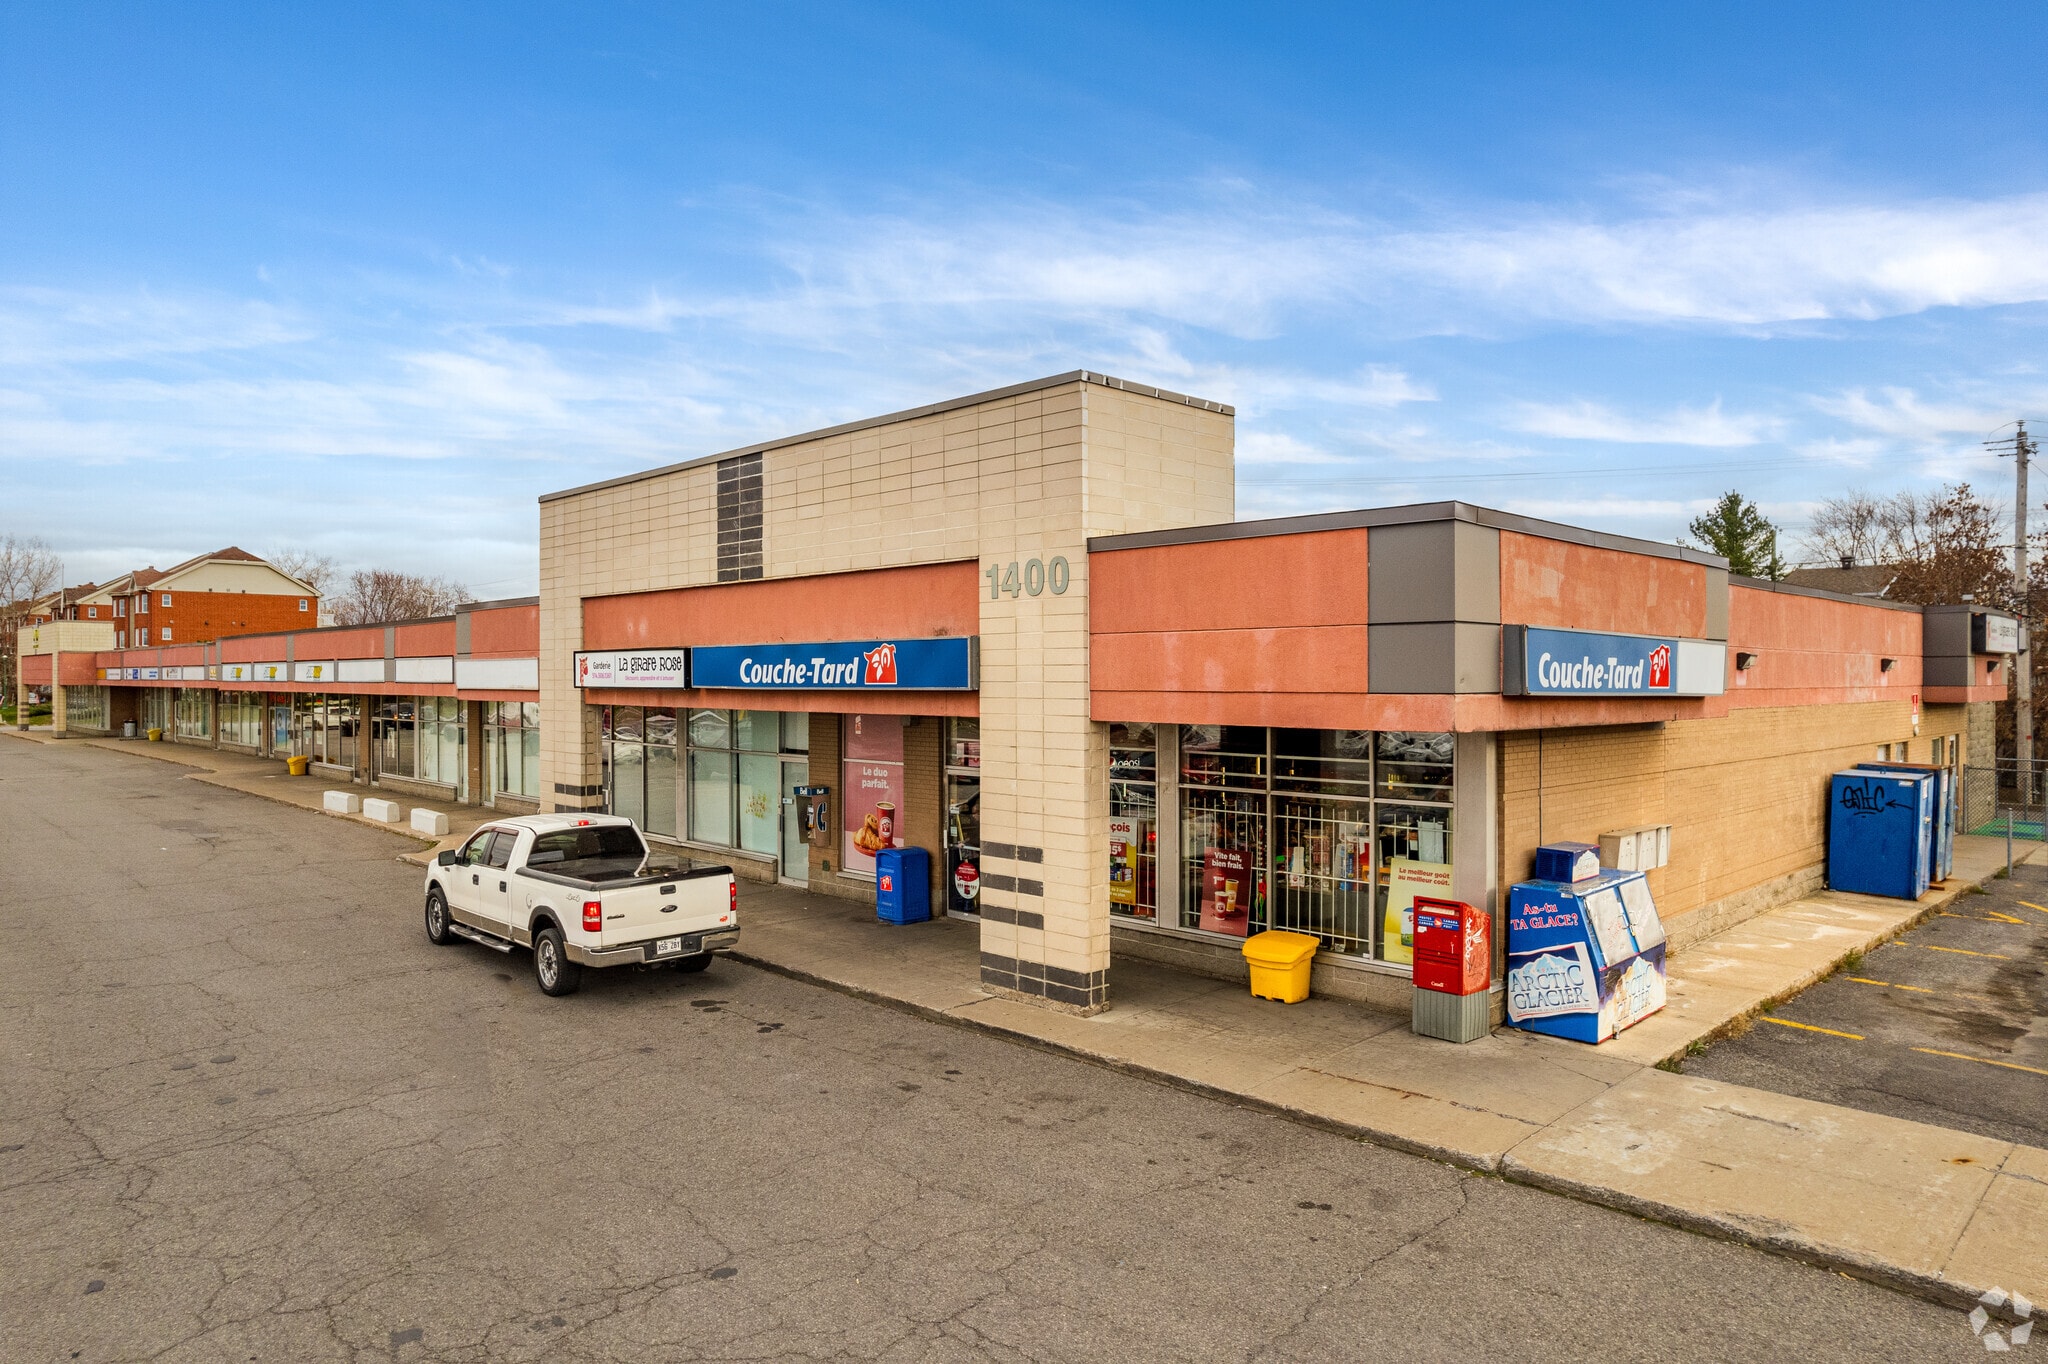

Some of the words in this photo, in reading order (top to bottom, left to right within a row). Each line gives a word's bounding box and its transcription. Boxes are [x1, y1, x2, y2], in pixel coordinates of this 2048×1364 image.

[986, 556, 1069, 599] 1400
[592, 661, 611, 670] Garderie
[739, 656, 860, 685] Couche-Tard
[1538, 652, 1644, 689] Couche-Tard
[863, 766, 872, 776] Le
[873, 767, 888, 777] duo
[861, 779, 889, 789] parfait.
[1214, 852, 1228, 860] Vite
[1229, 853, 1242, 862] fait,
[1227, 861, 1244, 870] frais.
[1407, 868, 1433, 877] meilleur
[1434, 871, 1450, 879] goût
[1406, 875, 1432, 884] meilleur
[1433, 878, 1450, 886] coût.
[1523, 903, 1559, 915] As-tu
[1529, 913, 1579, 928] GLACE?
[1510, 964, 1585, 993] ARCTIC
[1513, 987, 1589, 1010] GLACIER
